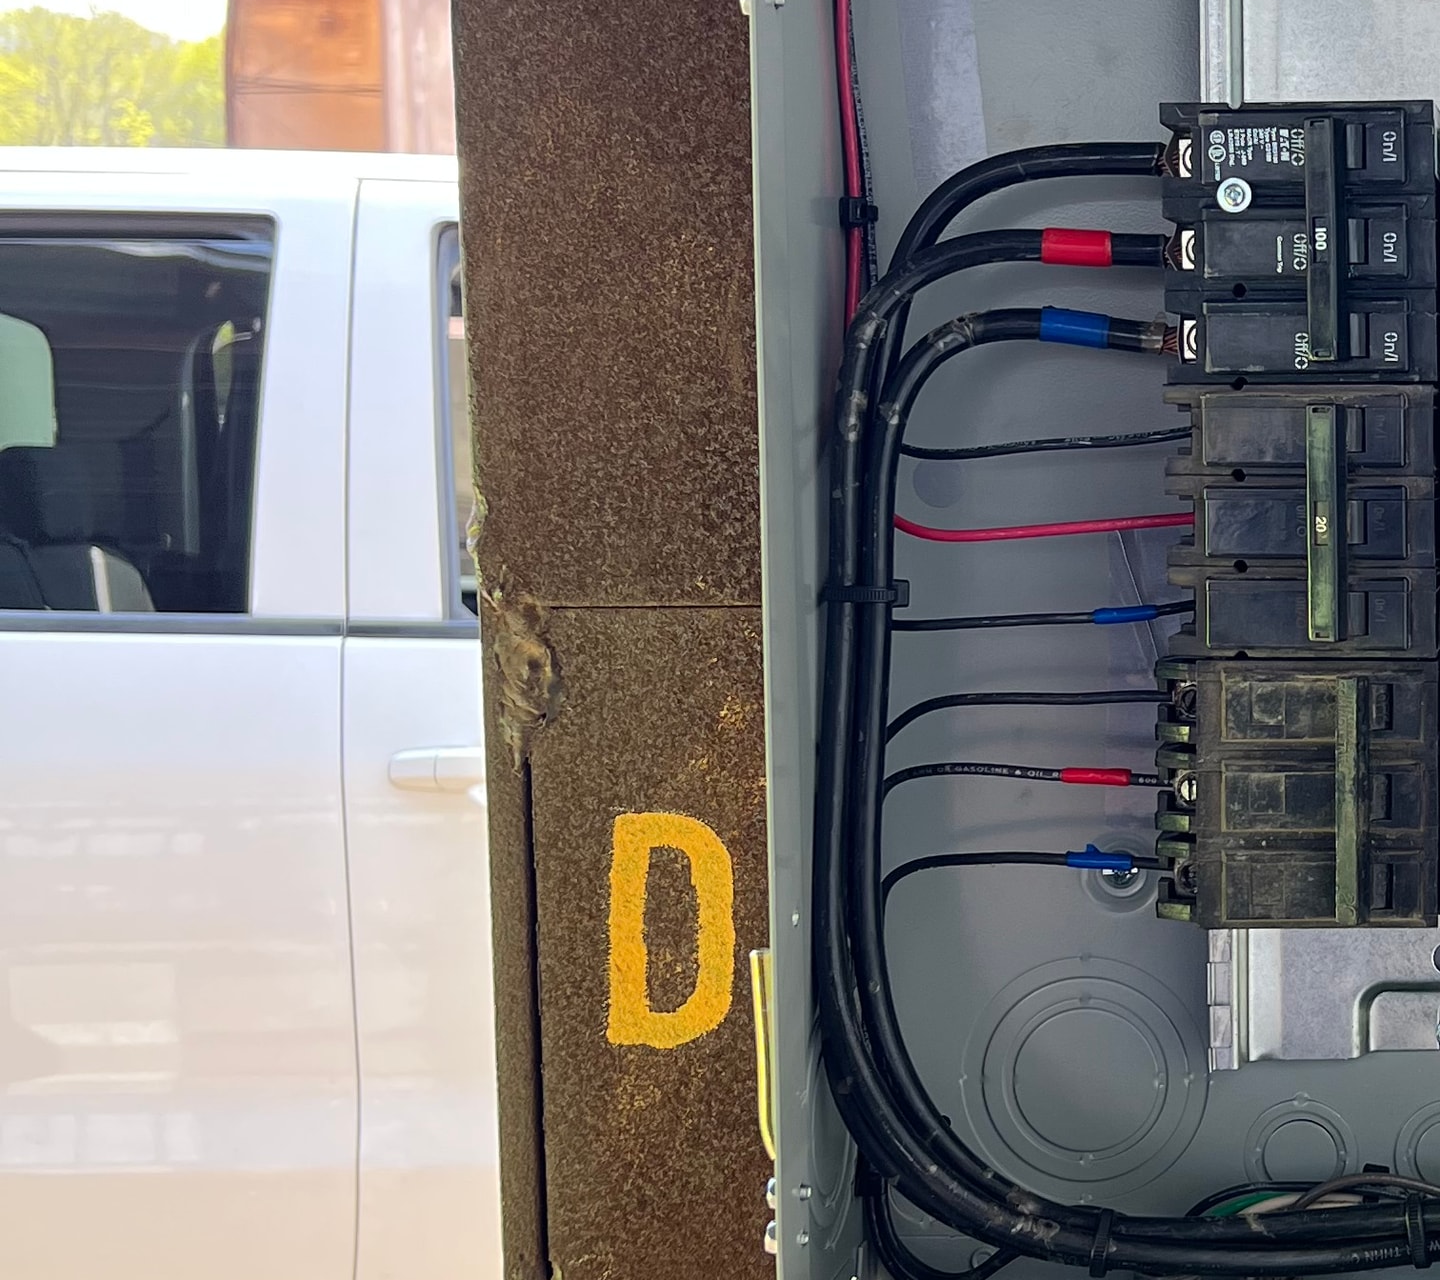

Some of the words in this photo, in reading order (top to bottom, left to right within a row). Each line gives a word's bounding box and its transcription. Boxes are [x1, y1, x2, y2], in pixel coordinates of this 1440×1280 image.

[1315, 227, 1326, 251] 100
[1315, 516, 1327, 533] 20
[954, 765, 1010, 775] GASOLINE
[607, 812, 736, 1049] D
